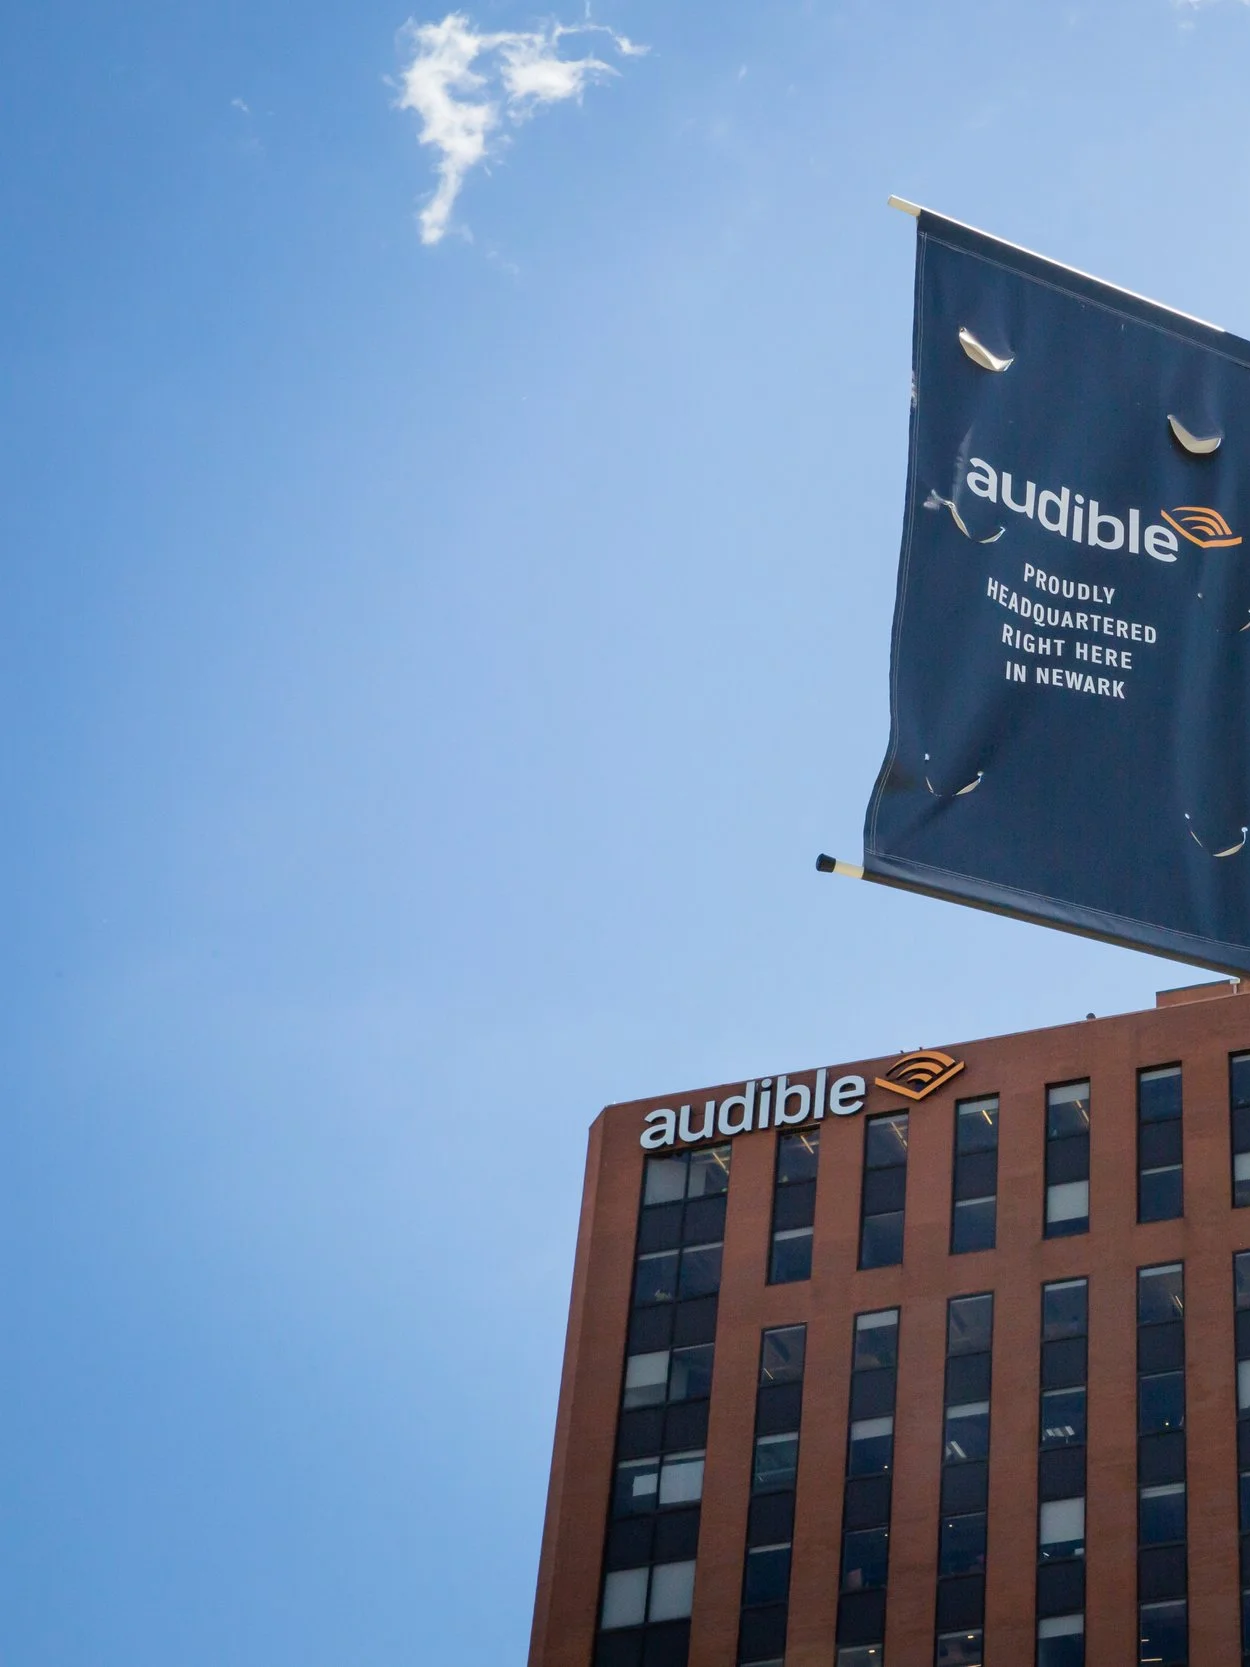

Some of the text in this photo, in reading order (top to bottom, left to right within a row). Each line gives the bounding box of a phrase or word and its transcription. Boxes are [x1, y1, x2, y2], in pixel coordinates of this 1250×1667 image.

[966, 457, 1178, 562] audible
[987, 577, 1157, 644] HEADQUARTERED
[1024, 563, 1115, 604] PROUDLY
[1002, 623, 1133, 670] RIGHT HERE
[1005, 661, 1125, 699] IN NEWARK
[639, 1068, 866, 1149] audible
